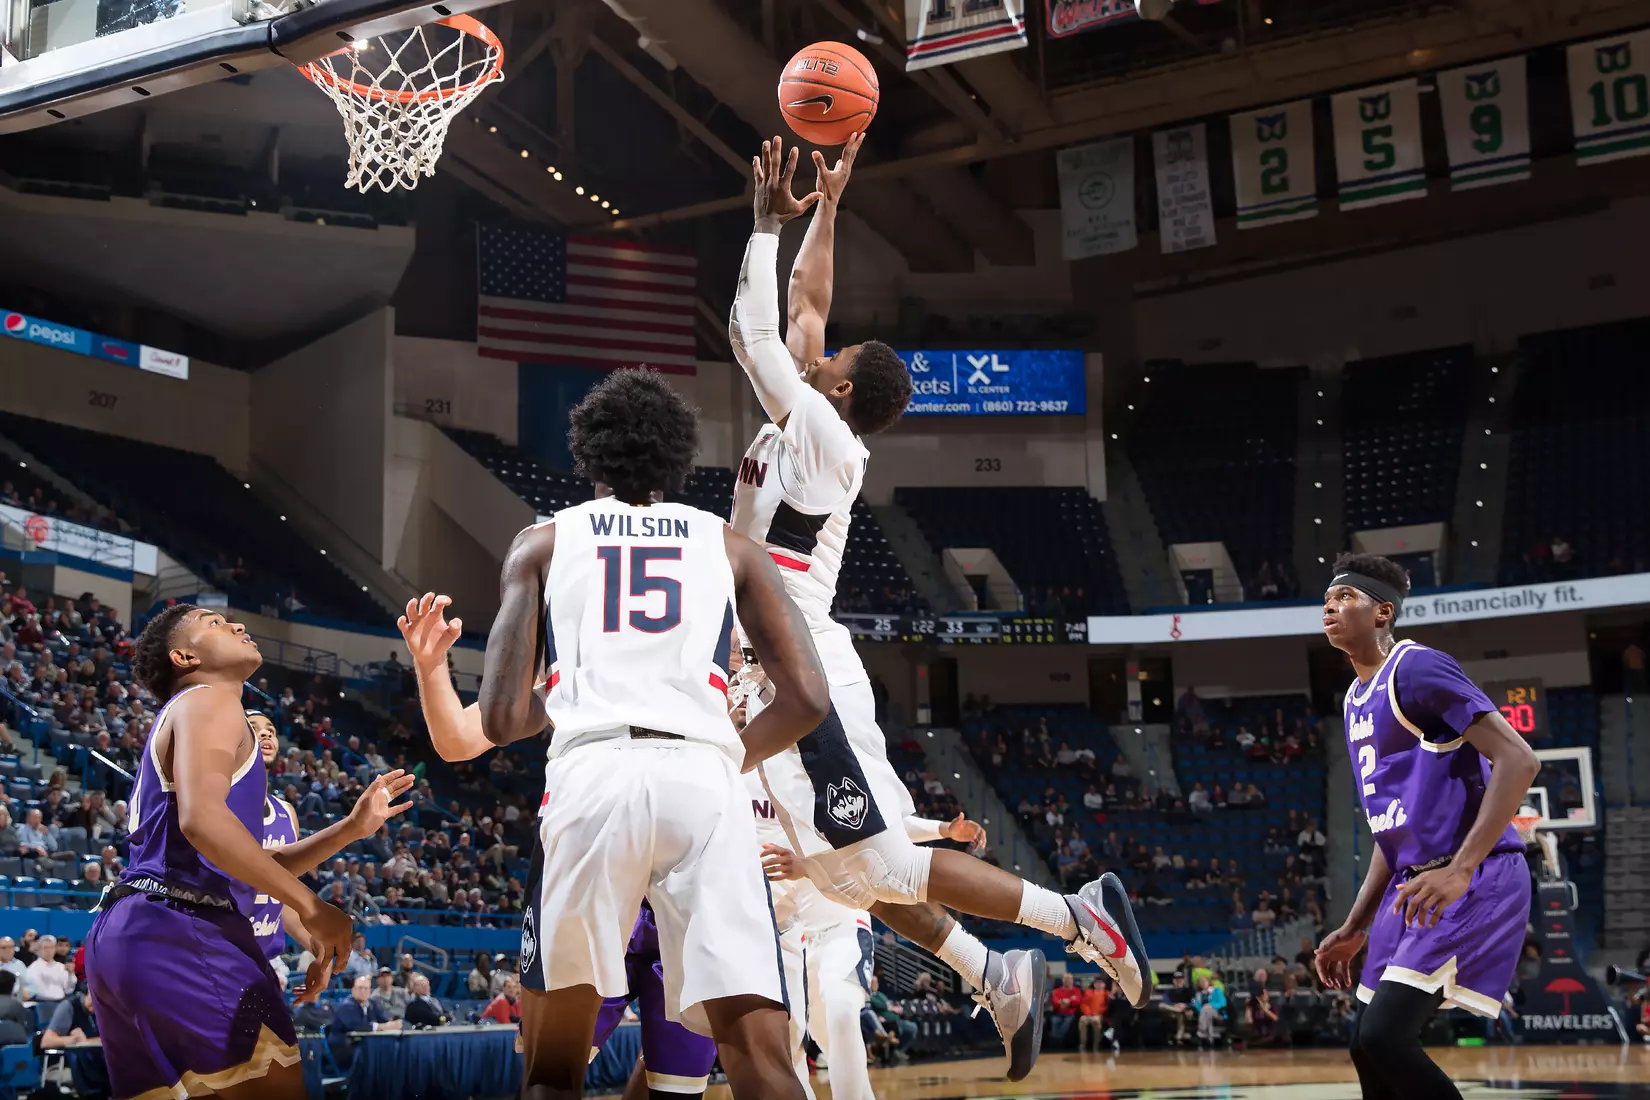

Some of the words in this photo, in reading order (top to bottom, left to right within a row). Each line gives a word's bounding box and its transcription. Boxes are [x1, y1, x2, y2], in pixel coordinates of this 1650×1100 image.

[1588, 74, 1649, 127] 10
[1470, 104, 1504, 153] 9
[1362, 125, 1395, 171] 5
[1260, 147, 1289, 195] 2
[29, 323, 76, 345] pepsi
[911, 352, 930, 373] &
[967, 353, 1010, 385] XL
[911, 377, 951, 395] kets
[88, 390, 118, 410] 207
[426, 398, 451, 414] 231
[904, 401, 971, 412] Center.com
[738, 456, 768, 488] NN
[975, 458, 1002, 472] 233
[589, 513, 689, 538] WILSON
[597, 545, 682, 634] 15
[1400, 604, 1426, 618] re
[1433, 589, 1547, 615] financially
[1554, 585, 1584, 603] fit.
[874, 618, 892, 631] 25
[946, 620, 964, 634] 33
[1358, 744, 1377, 797] 2
[1521, 1014, 1615, 1031] TRAVELERS
